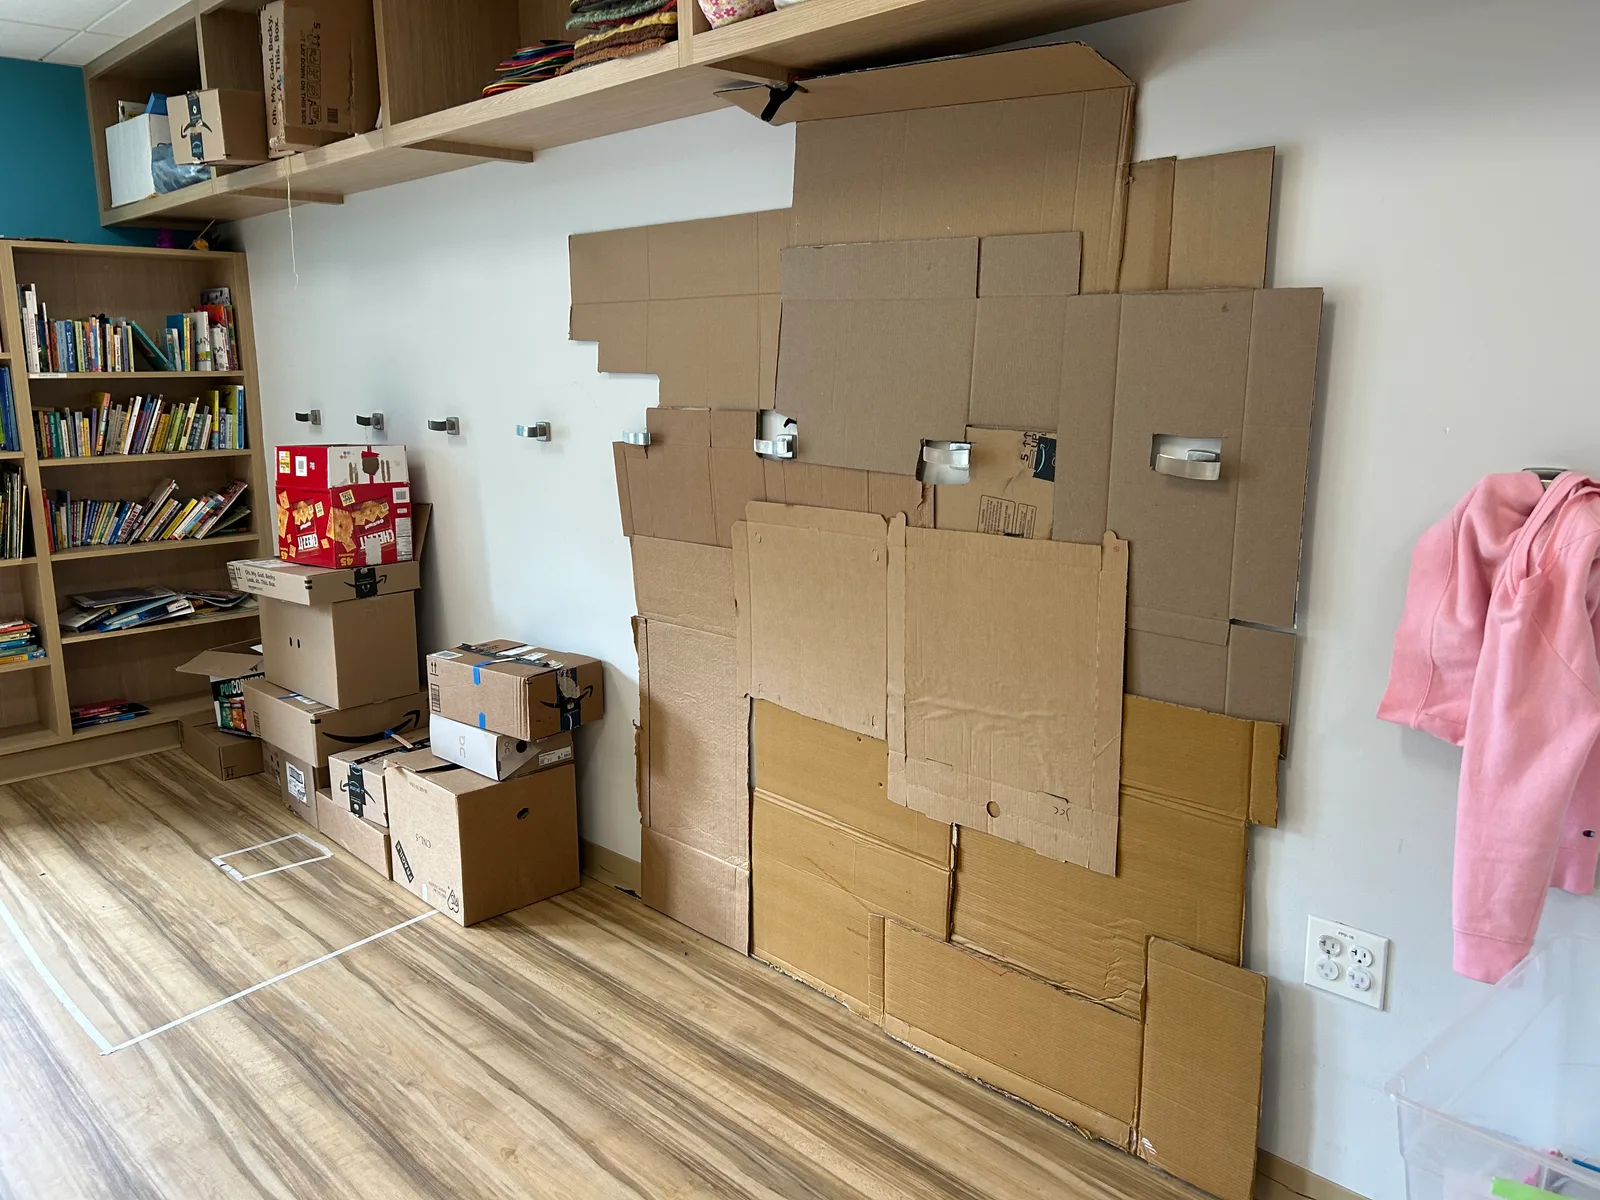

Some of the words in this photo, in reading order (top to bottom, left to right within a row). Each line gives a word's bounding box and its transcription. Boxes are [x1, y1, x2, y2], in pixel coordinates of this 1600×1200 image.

[300, 80, 306, 91] ON
[1030, 433, 1039, 448] UP
[1020, 453, 1029, 462] 5
[340, 557, 354, 567] 45
[396, 842, 413, 881] FRAGILE
